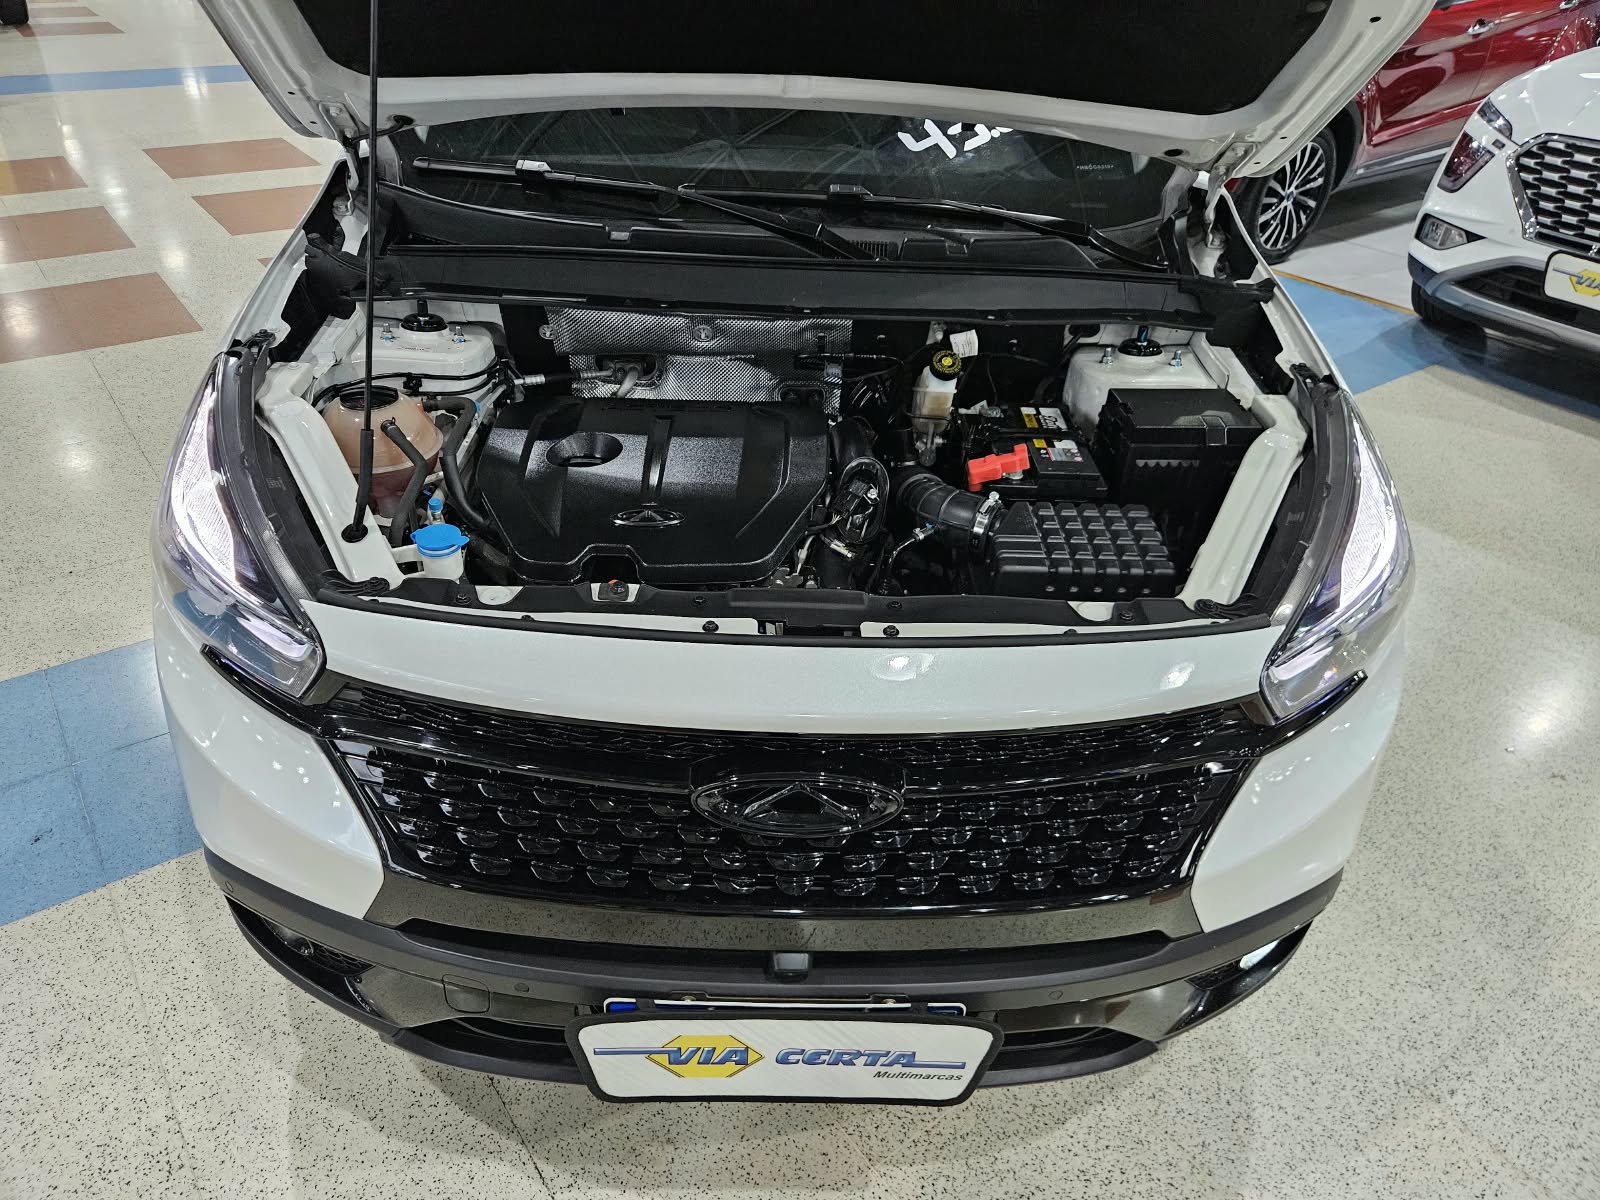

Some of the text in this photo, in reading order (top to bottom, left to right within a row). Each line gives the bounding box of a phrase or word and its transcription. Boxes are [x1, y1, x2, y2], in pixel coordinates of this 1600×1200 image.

[667, 1046, 917, 1068] VIA CERTA
[872, 1070, 964, 1082] Multimarcas
